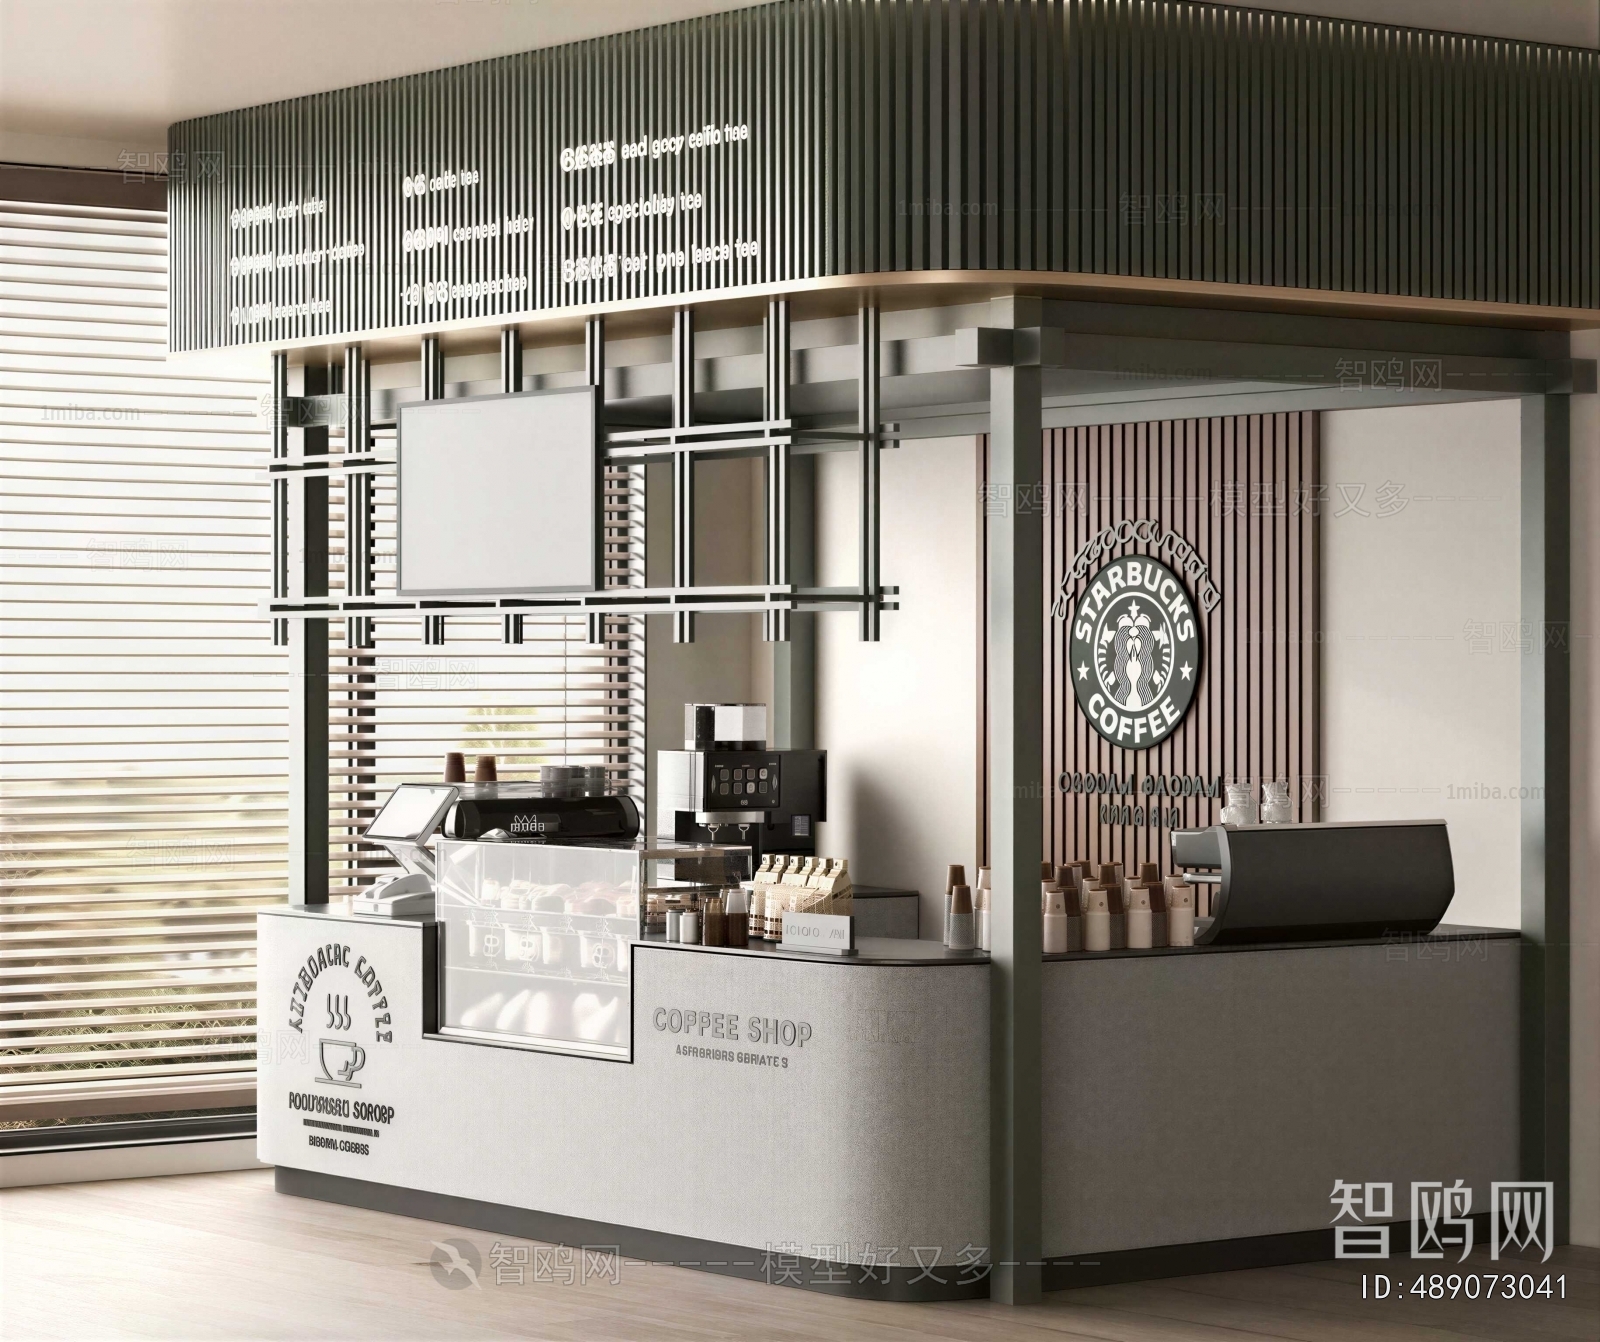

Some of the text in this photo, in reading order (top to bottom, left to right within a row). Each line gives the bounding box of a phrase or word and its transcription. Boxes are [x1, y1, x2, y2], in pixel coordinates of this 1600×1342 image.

[1075, 561, 1195, 643] STARBUCKS
[1088, 693, 1181, 744] COFFEE
[747, 1016, 813, 1048] SHOP
